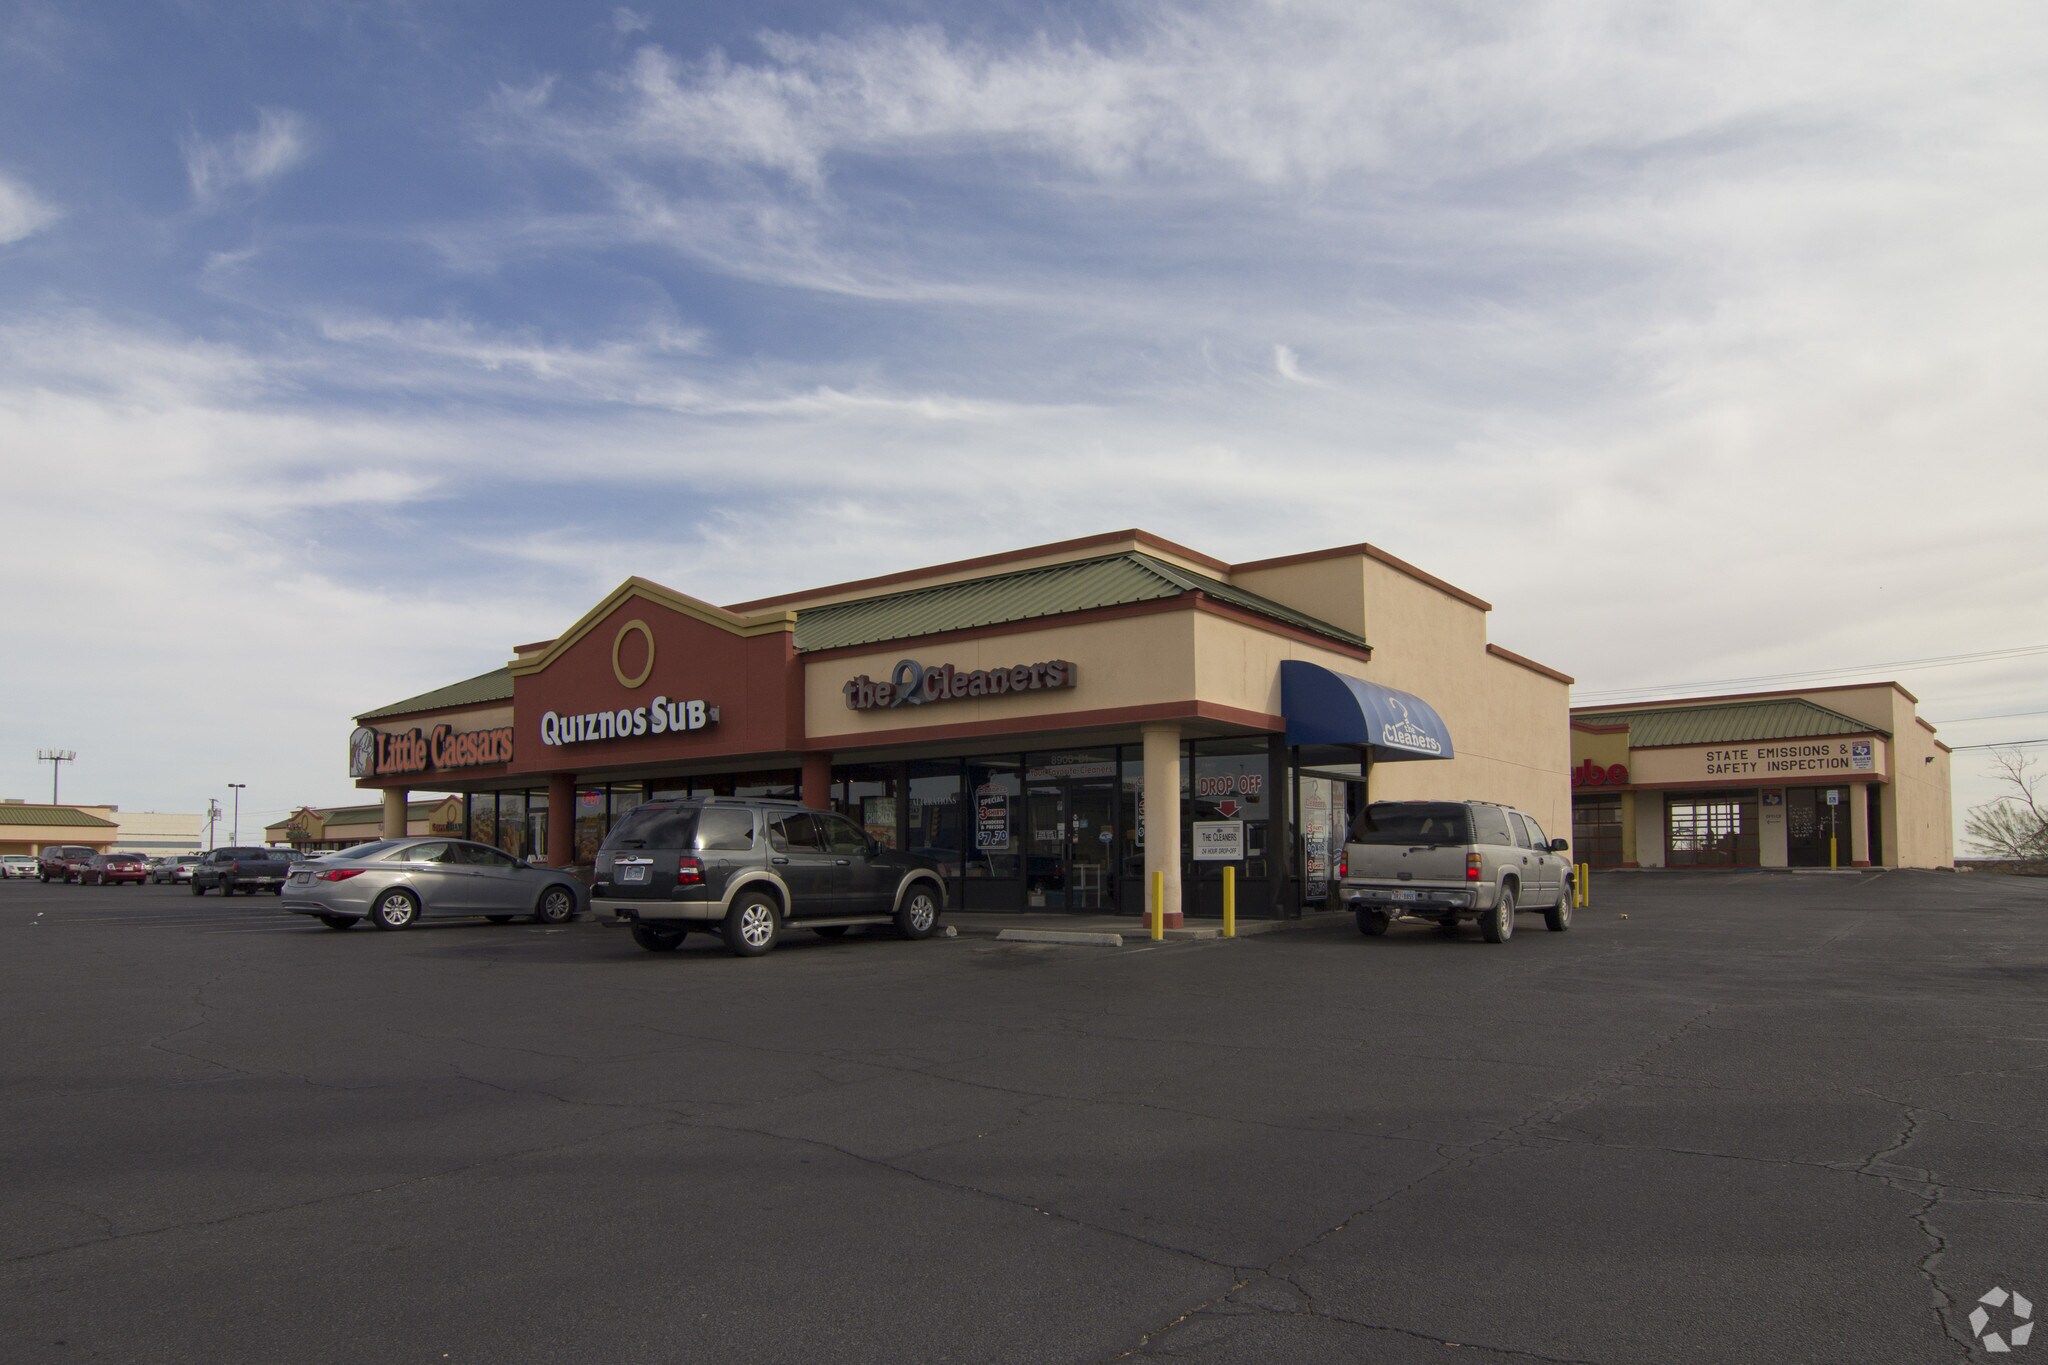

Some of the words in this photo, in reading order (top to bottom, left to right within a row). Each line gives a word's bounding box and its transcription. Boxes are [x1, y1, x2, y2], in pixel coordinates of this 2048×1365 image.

[843, 675, 894, 710] the
[923, 660, 1069, 701] Cleaners
[1384, 723, 1438, 750] Cleaners
[376, 728, 428, 775] Little
[431, 724, 513, 768] Caesars
[1706, 750, 1749, 761] STATE
[1758, 745, 1830, 759] EMISSIONS
[1839, 744, 1848, 755] &
[1080, 765, 1113, 775] Cleaners
[1707, 762, 1757, 774] SAFETY
[1767, 757, 1849, 771] INSPECTION
[1199, 775, 1235, 796] DROP
[1238, 774, 1262, 794] OFF
[980, 795, 1004, 806] SPECIAL
[979, 806, 988, 820] 3
[1202, 832, 1212, 841] THE
[1213, 832, 1237, 842] CLEANERS
